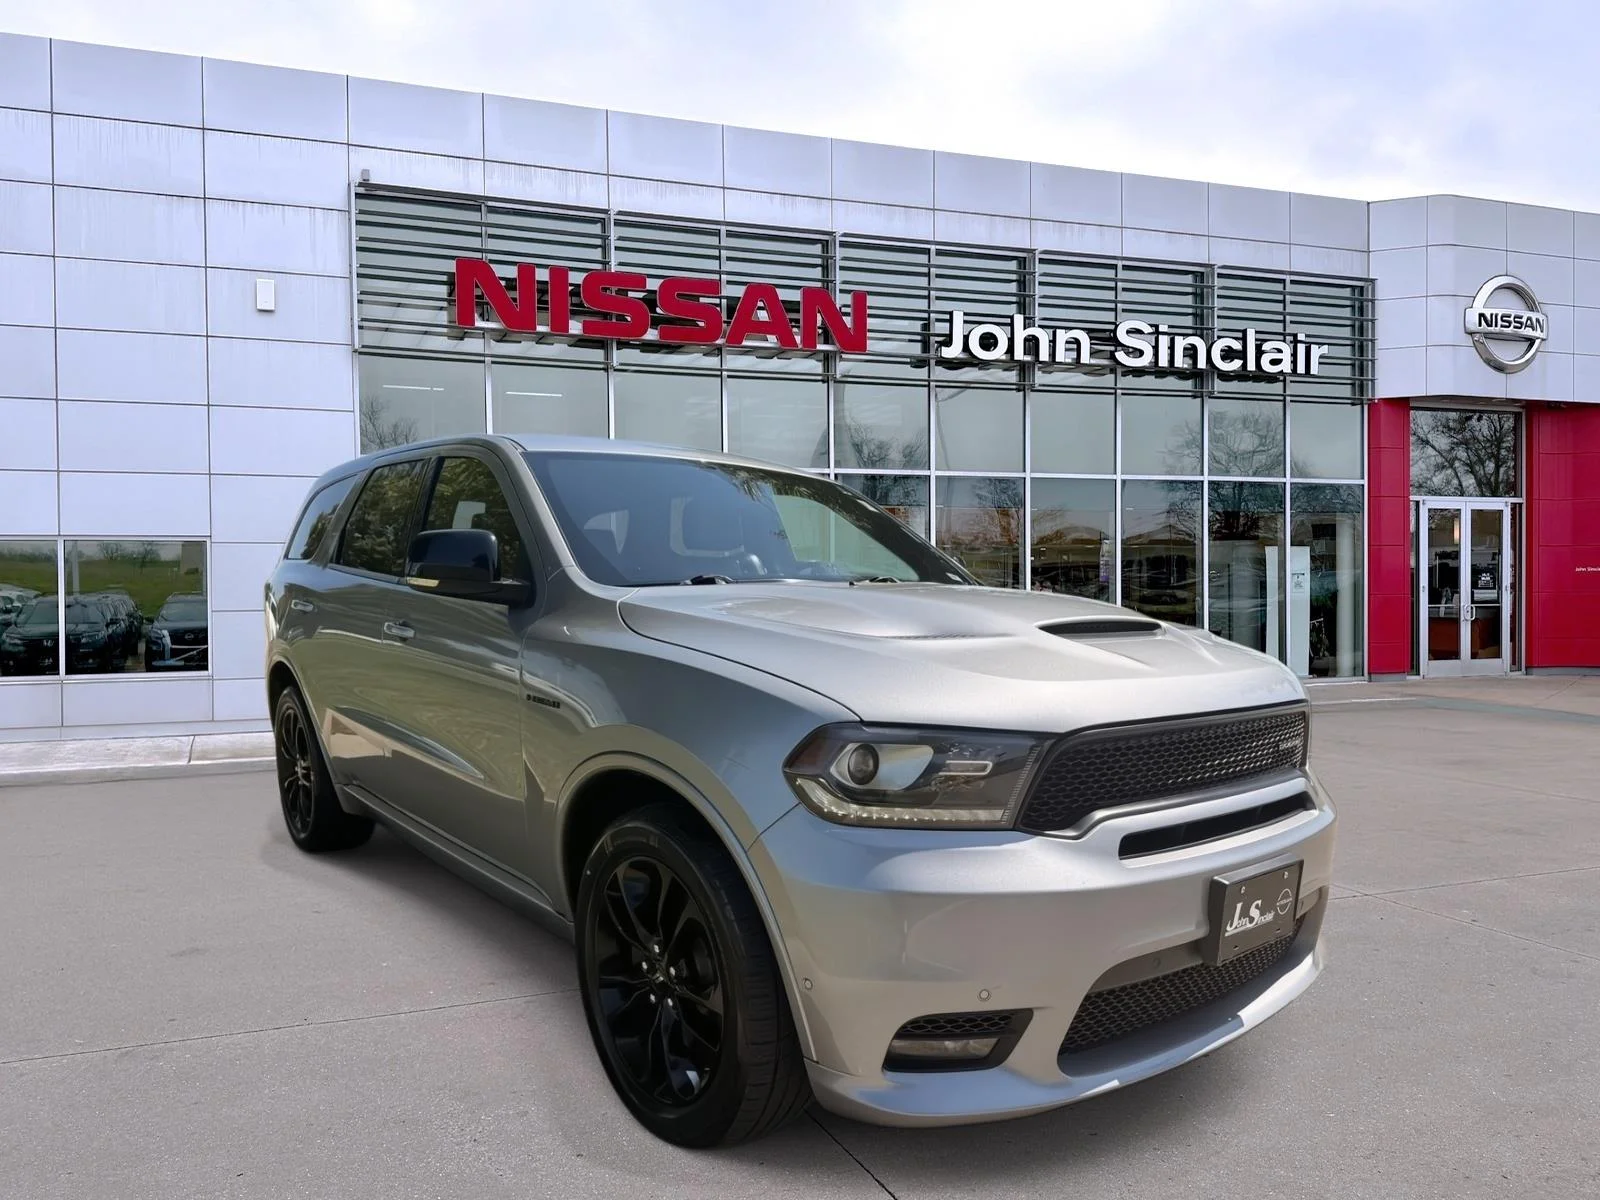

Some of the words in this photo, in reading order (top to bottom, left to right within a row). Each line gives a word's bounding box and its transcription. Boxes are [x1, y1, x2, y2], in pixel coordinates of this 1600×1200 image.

[455, 257, 868, 353] NISSAN
[1477, 312, 1545, 333] NISSAN
[940, 310, 1090, 364] John
[1113, 319, 1329, 376] Sinclair
